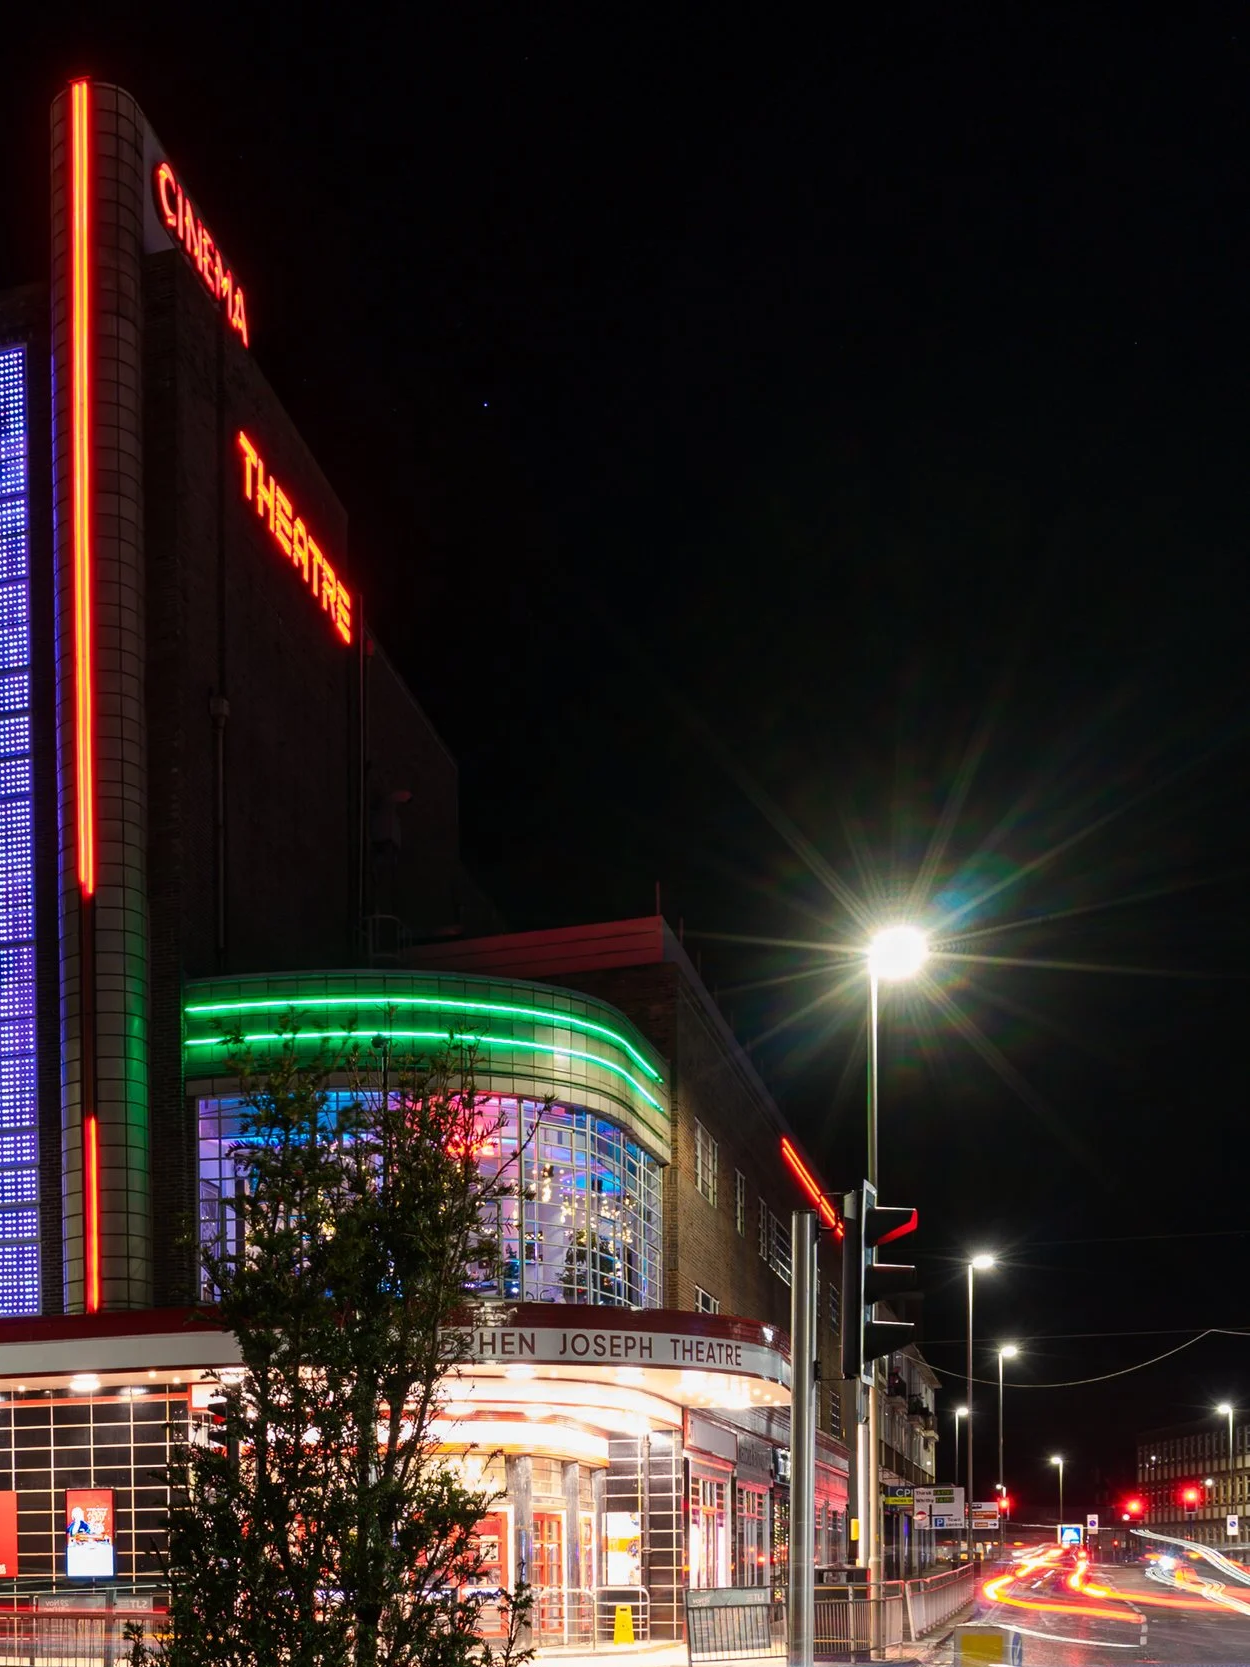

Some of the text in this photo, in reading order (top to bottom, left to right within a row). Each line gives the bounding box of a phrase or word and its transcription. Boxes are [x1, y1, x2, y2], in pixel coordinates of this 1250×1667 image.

[157, 162, 248, 348] CINEMA
[238, 430, 350, 644] THEATRE
[438, 1332, 742, 1367] EPHEN JOSEPH THEATRE
[895, 1488, 913, 1497] CP
